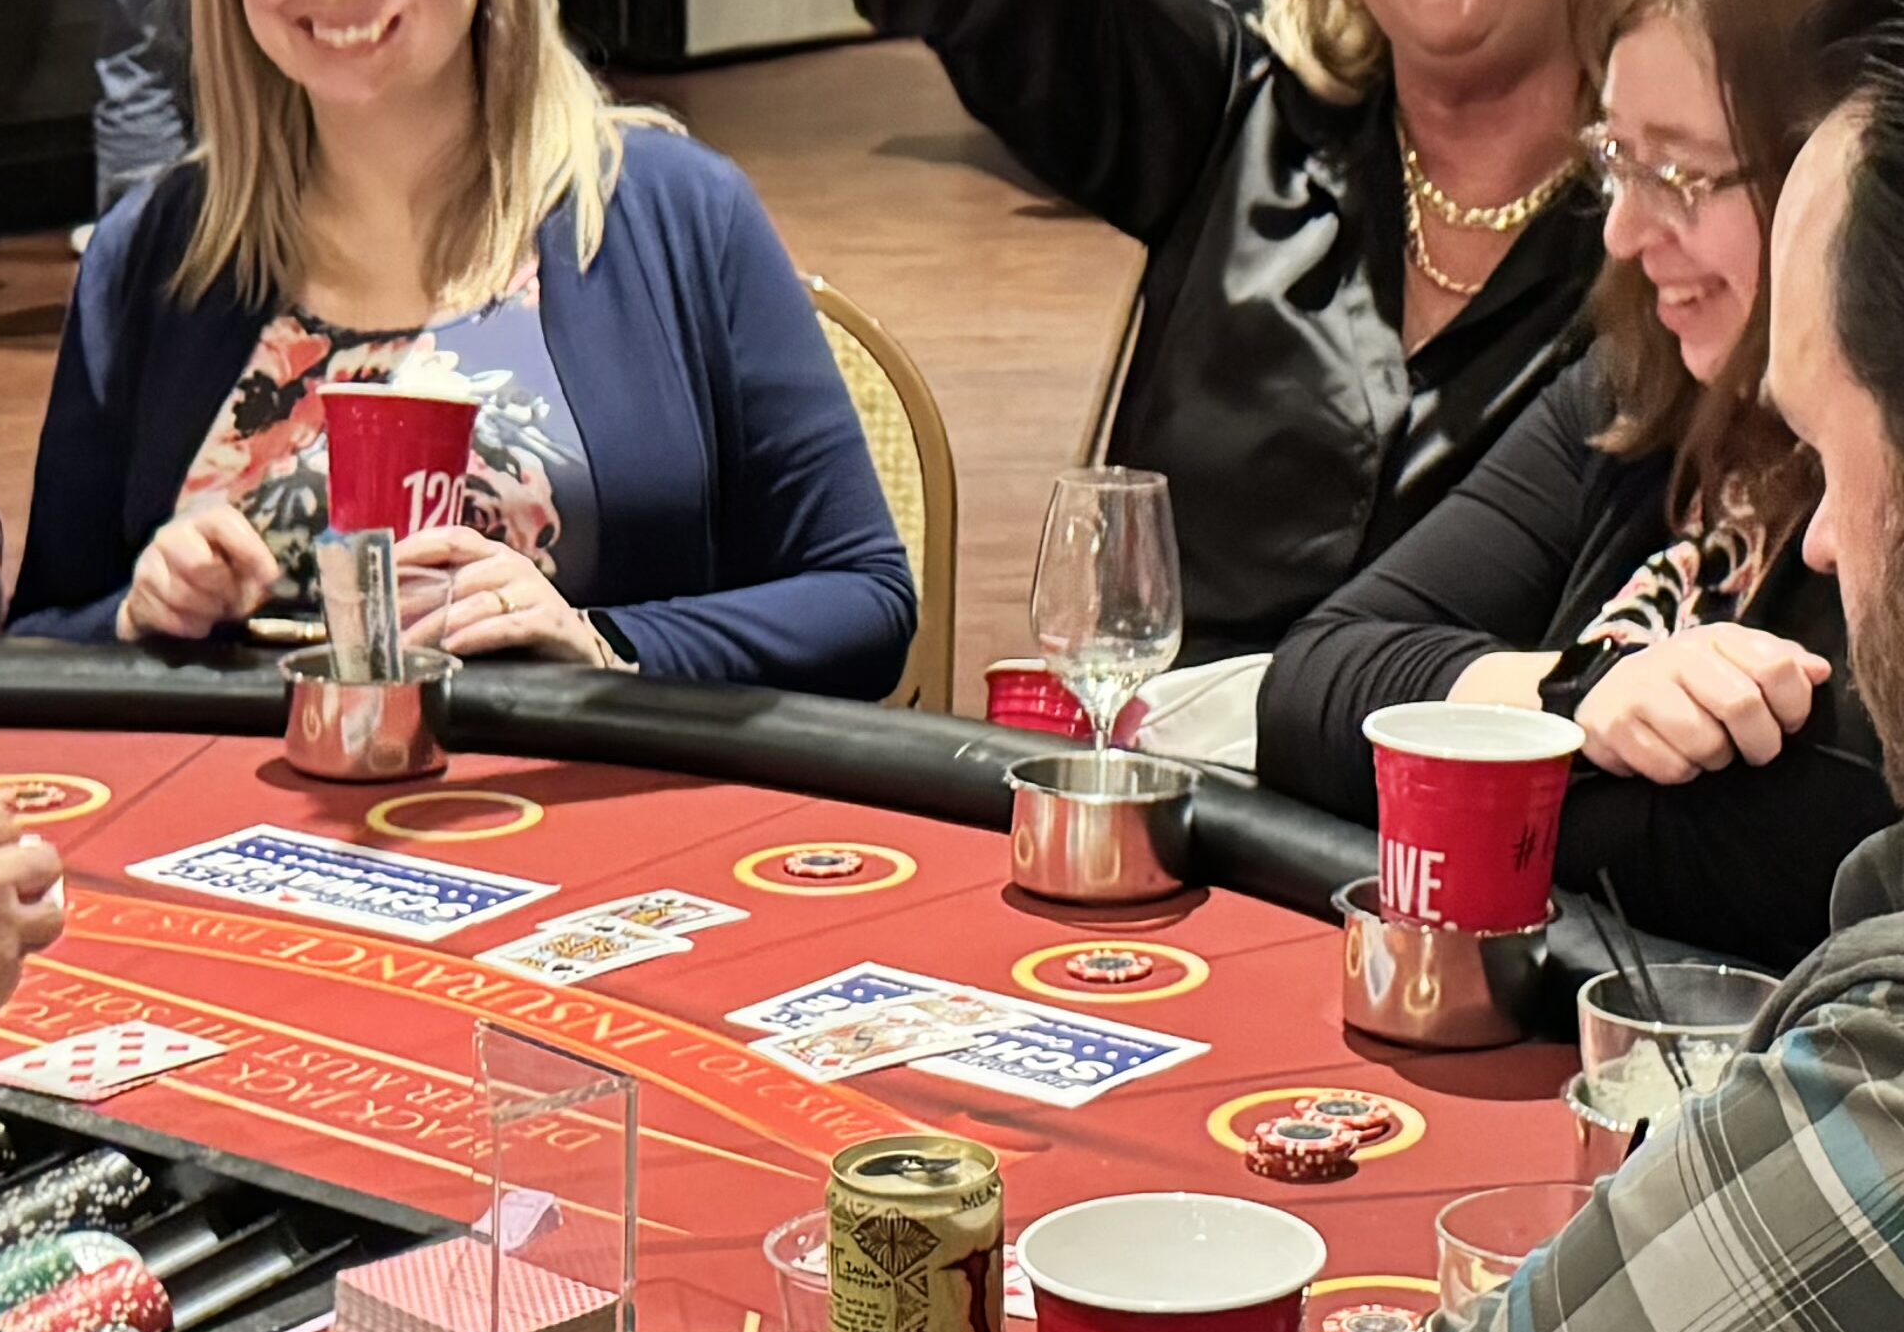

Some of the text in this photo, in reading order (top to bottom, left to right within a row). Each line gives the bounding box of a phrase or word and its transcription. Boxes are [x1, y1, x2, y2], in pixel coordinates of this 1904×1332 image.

[38, 983, 171, 1019] SOFT
[261, 937, 672, 1049] INSURANCE
[220, 1062, 360, 1110] JACK
[253, 1044, 409, 1091] MUST
